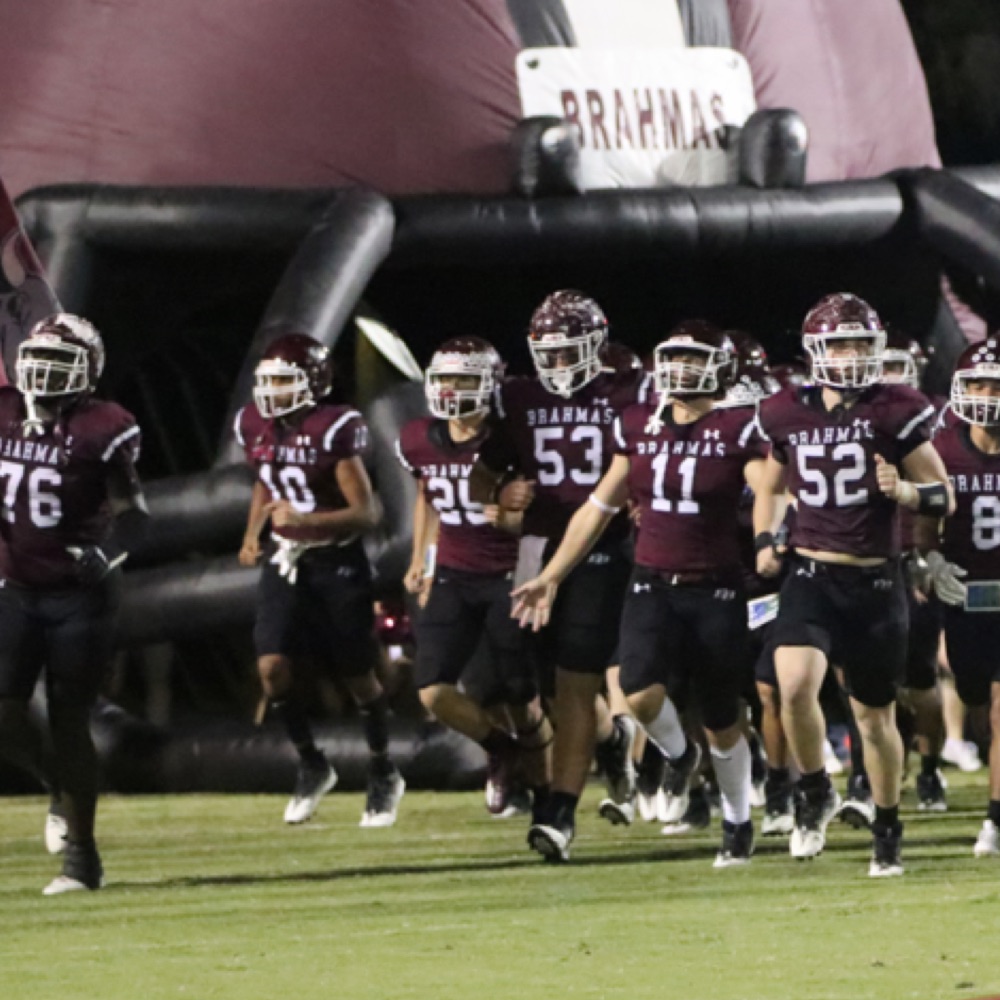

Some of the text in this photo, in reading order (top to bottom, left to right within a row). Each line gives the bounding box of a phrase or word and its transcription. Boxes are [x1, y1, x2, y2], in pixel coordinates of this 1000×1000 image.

[560, 89, 729, 150] BRAHMAS
[527, 407, 613, 425] BRAHMAS
[534, 426, 602, 486] 53
[637, 442, 725, 457] BRAHMAS
[796, 442, 869, 507] 52
[0, 460, 62, 528] 76
[651, 454, 699, 514] 11
